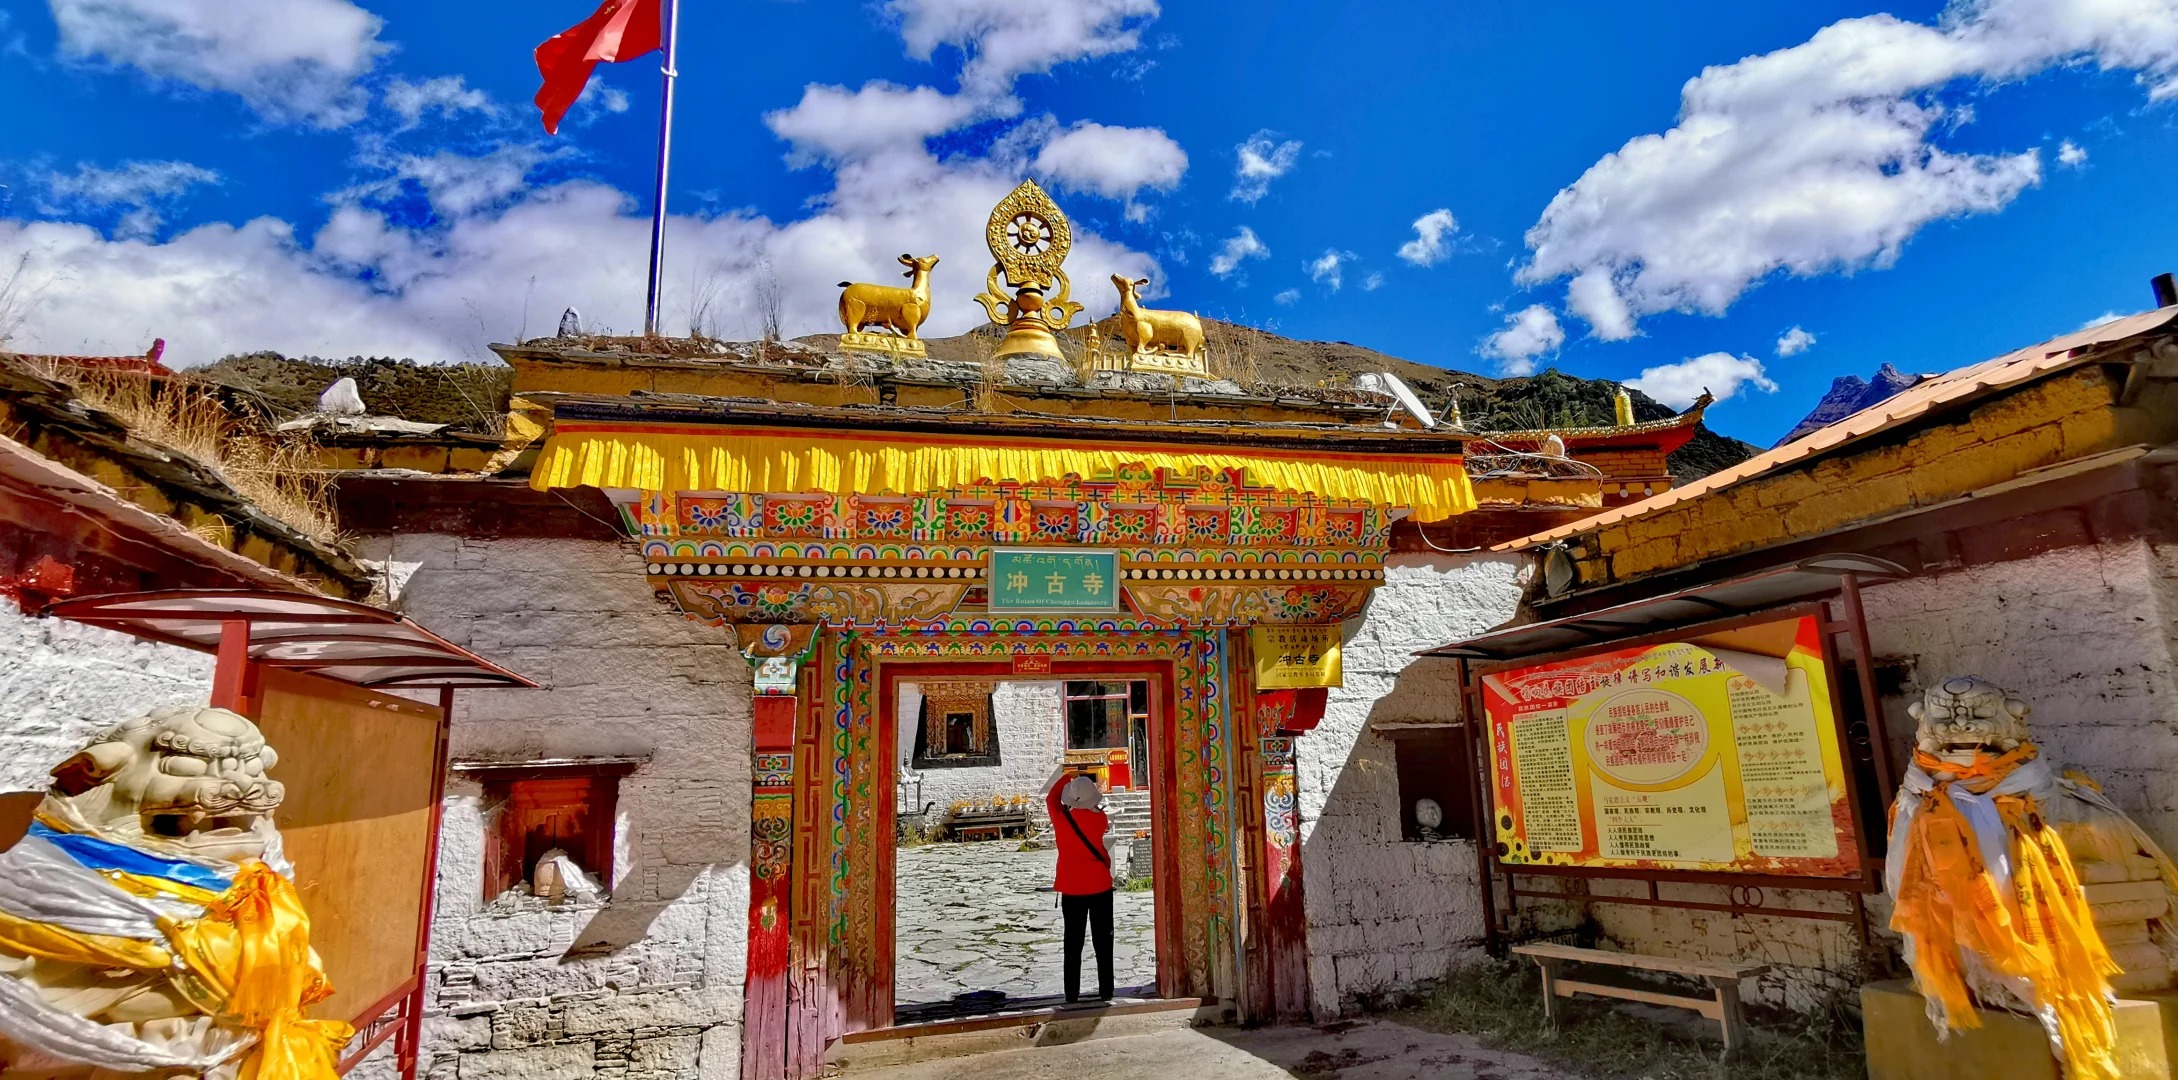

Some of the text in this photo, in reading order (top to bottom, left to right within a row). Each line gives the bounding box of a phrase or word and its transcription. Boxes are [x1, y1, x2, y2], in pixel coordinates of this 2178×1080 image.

[1006, 570, 1104, 595] 冲古寺
[1279, 654, 1320, 665] 冲古寺
[1628, 657, 1728, 684] 谱写和谐发展新
[1496, 722, 1511, 788] 民族团结
